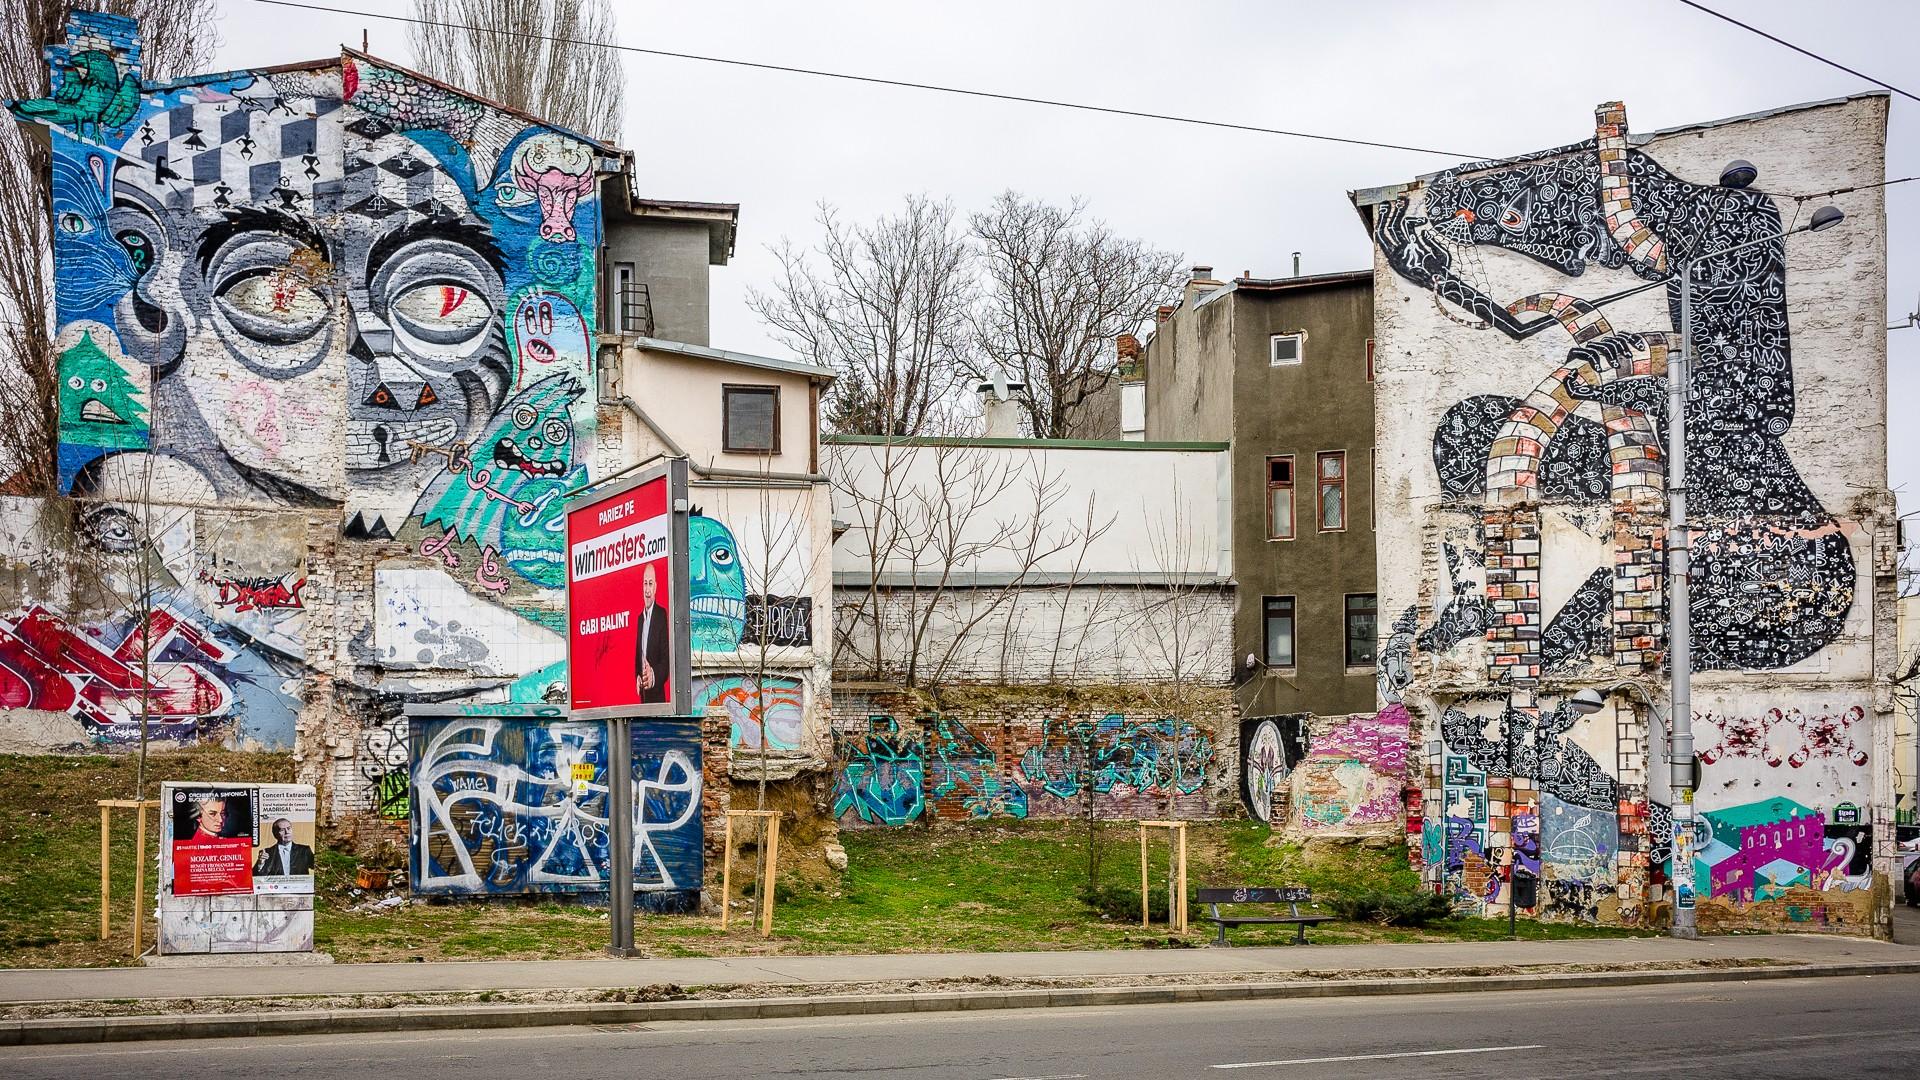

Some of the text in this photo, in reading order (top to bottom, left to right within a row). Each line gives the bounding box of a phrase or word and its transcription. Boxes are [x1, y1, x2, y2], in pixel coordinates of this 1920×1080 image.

[598, 500, 635, 526] PARIEZ PE
[574, 533, 666, 577] winmasters.com
[580, 610, 630, 636] GABI BALINT
